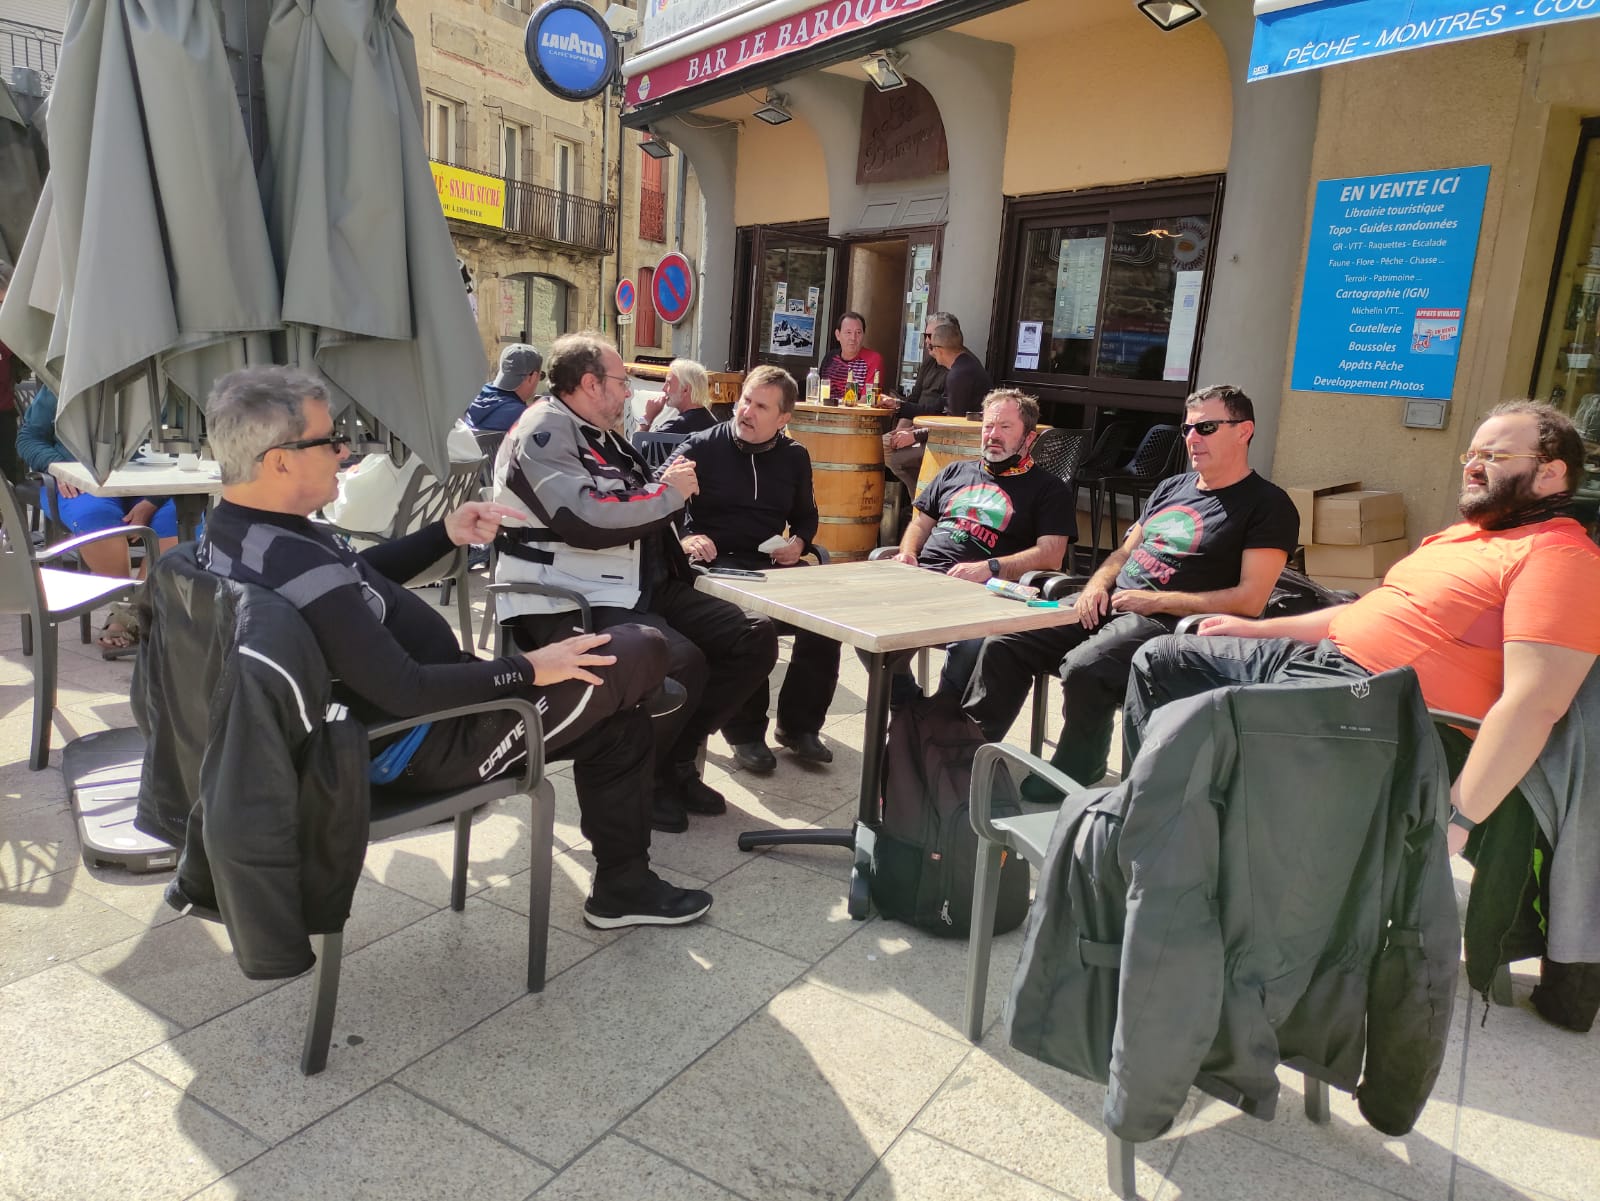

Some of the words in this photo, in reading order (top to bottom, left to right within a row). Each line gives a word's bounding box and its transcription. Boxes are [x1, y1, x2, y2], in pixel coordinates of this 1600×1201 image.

[1283, 33, 1361, 67] PÊCHE
[1374, 4, 1506, 49] MONTRES
[541, 32, 604, 60] LAVAZZA
[686, 48, 727, 82] BAR
[736, 31, 767, 63] LE
[449, 178, 475, 203] SNACK
[477, 185, 501, 209] SUCRÉ
[1340, 184, 1366, 203] EN
[1369, 179, 1429, 200] VENTE
[1431, 175, 1461, 195] ICI
[1344, 206, 1386, 219] Librairie
[1387, 203, 1445, 217] touristique
[1328, 224, 1352, 237] Topo
[1359, 222, 1393, 234] Guides
[1394, 218, 1458, 232] randonnées
[1348, 242, 1363, 250] VTT
[1368, 241, 1406, 251] Raquettes
[1412, 238, 1447, 248] Escalade
[1329, 259, 1350, 267] Faune
[1356, 257, 1375, 266] Flore
[1380, 256, 1404, 265] Pêche
[1409, 255, 1438, 265] Chasse
[1344, 274, 1368, 283] Terroir
[1373, 273, 1415, 282] Patrimoine
[1335, 288, 1400, 302] Cartographie
[1402, 287, 1430, 300] (IGN)
[1351, 306, 1383, 315] Michelin
[1348, 322, 1402, 334] Coutellerie
[1348, 341, 1397, 353] Boussoles
[1338, 359, 1372, 372] Appâts
[1374, 360, 1404, 372] Pêche
[1313, 375, 1389, 390] Developpement
[1389, 379, 1425, 391] Photos
[478, 696, 549, 779] DAINEE
